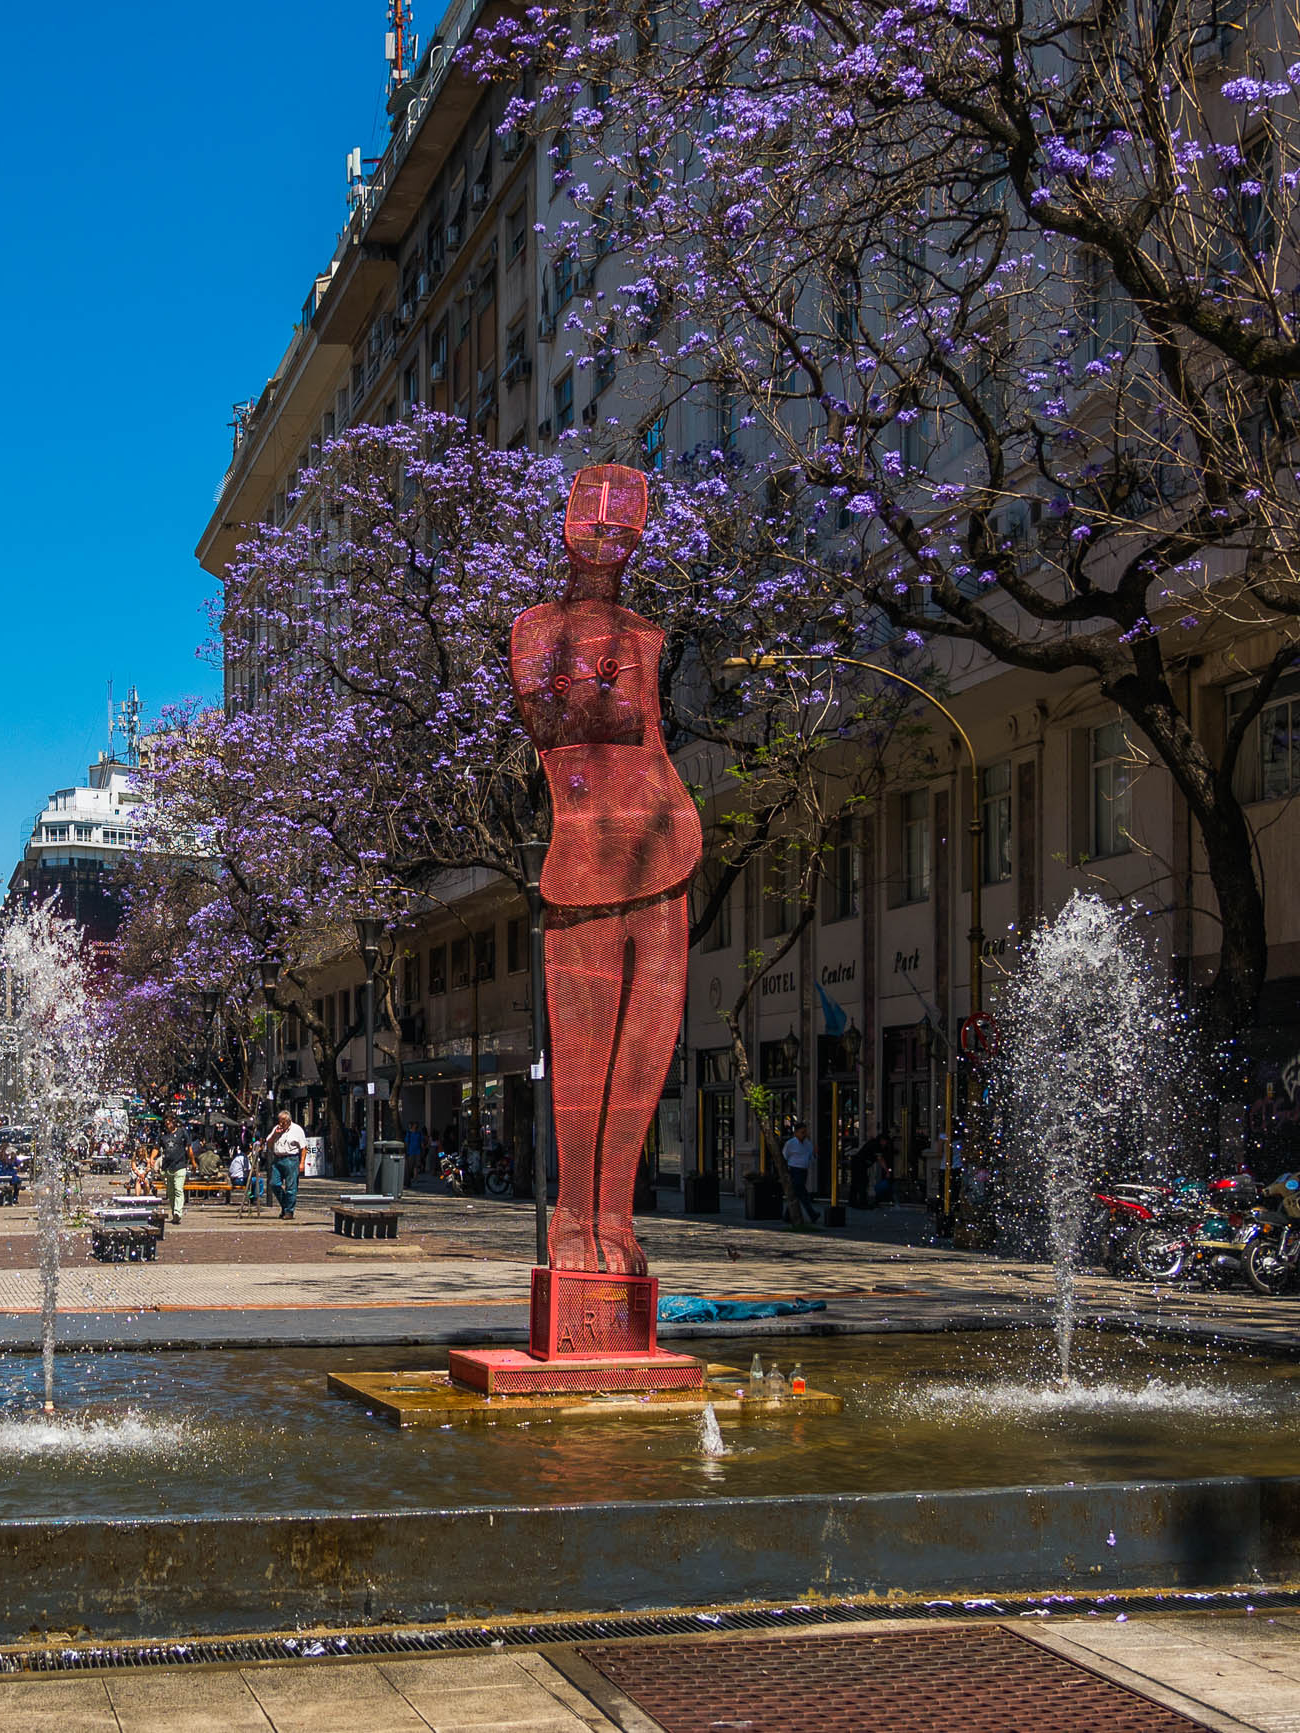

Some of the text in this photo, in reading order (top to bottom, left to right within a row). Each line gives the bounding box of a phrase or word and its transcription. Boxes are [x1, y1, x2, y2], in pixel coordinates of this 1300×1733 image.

[762, 972, 796, 996] HOTEL
[821, 960, 856, 986] Central
[894, 948, 920, 973] Park
[307, 1146, 322, 1154] SEX
